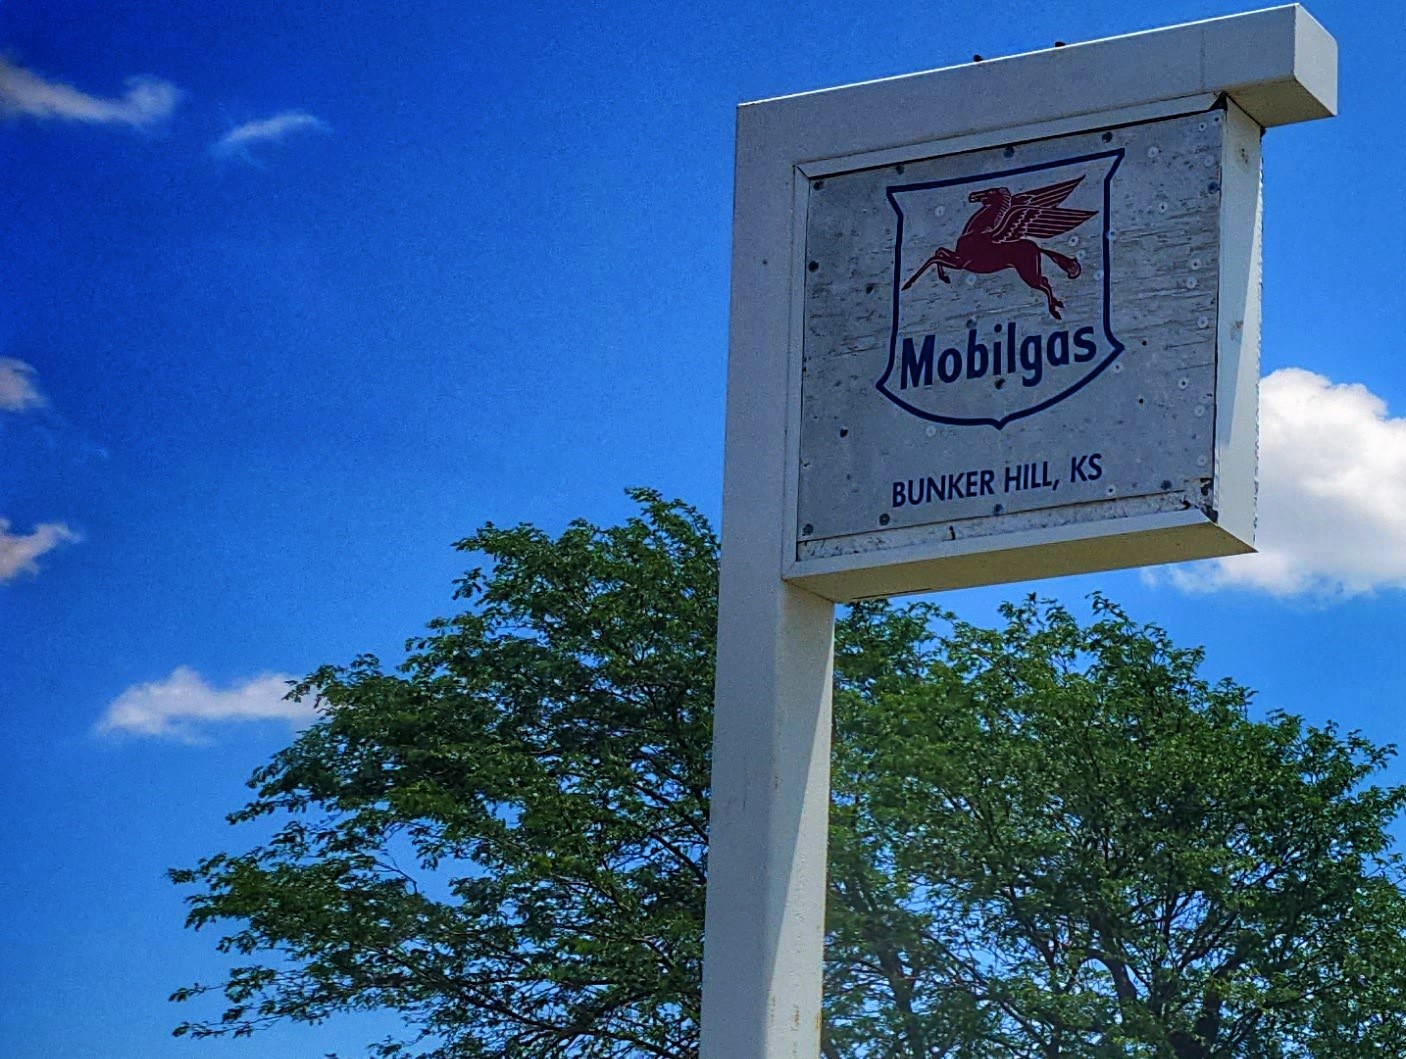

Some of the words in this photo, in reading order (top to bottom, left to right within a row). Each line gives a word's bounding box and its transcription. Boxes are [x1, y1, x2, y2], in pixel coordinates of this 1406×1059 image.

[900, 322, 1097, 390] Mobilgas
[892, 469, 995, 508] BUNKER
[1004, 461, 1060, 493] HILL,
[1070, 453, 1103, 483] KS
